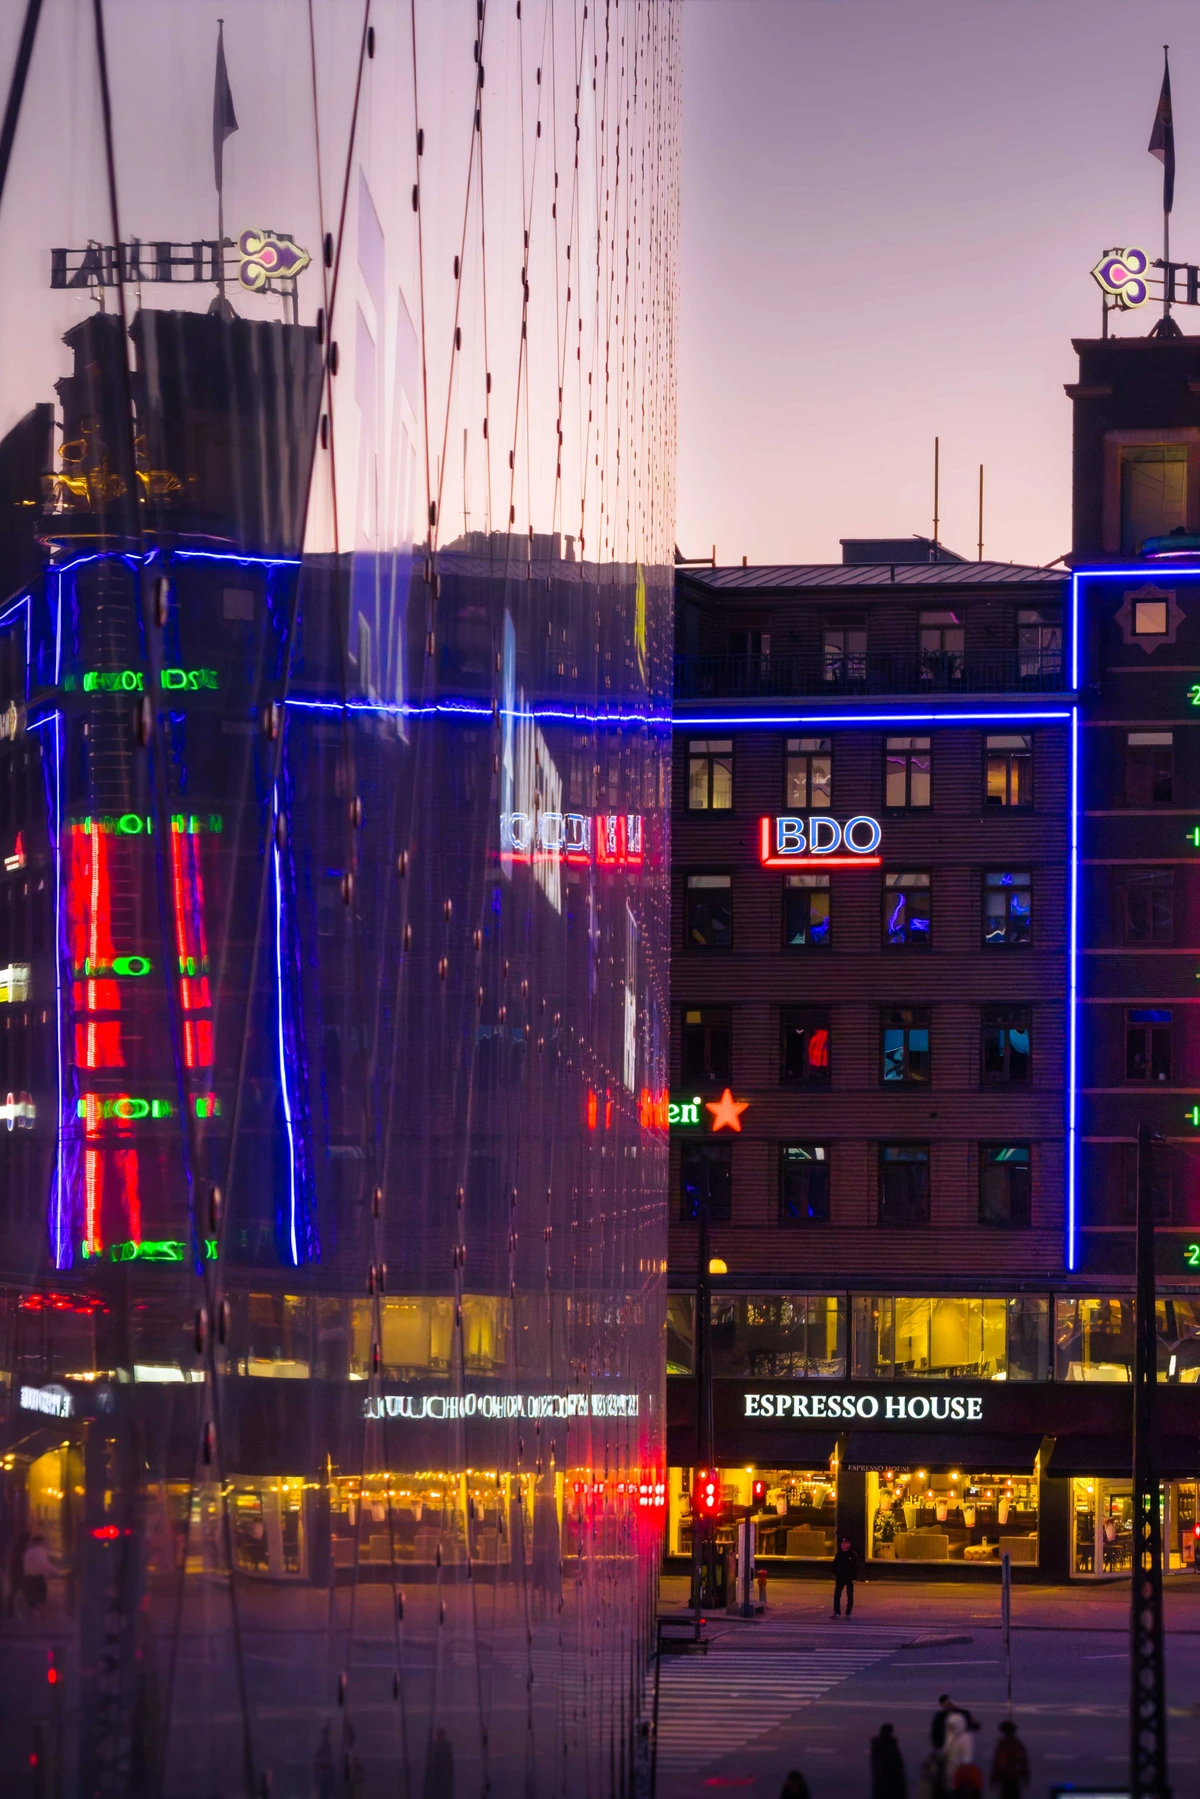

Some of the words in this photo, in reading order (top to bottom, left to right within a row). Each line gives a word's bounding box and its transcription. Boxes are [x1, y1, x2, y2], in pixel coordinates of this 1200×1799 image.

[776, 816, 882, 854] BDO
[744, 1394, 879, 1418] ESPRESSO
[885, 1396, 983, 1420] HOUSE
[848, 1464, 884, 1472] ESPRESSO
